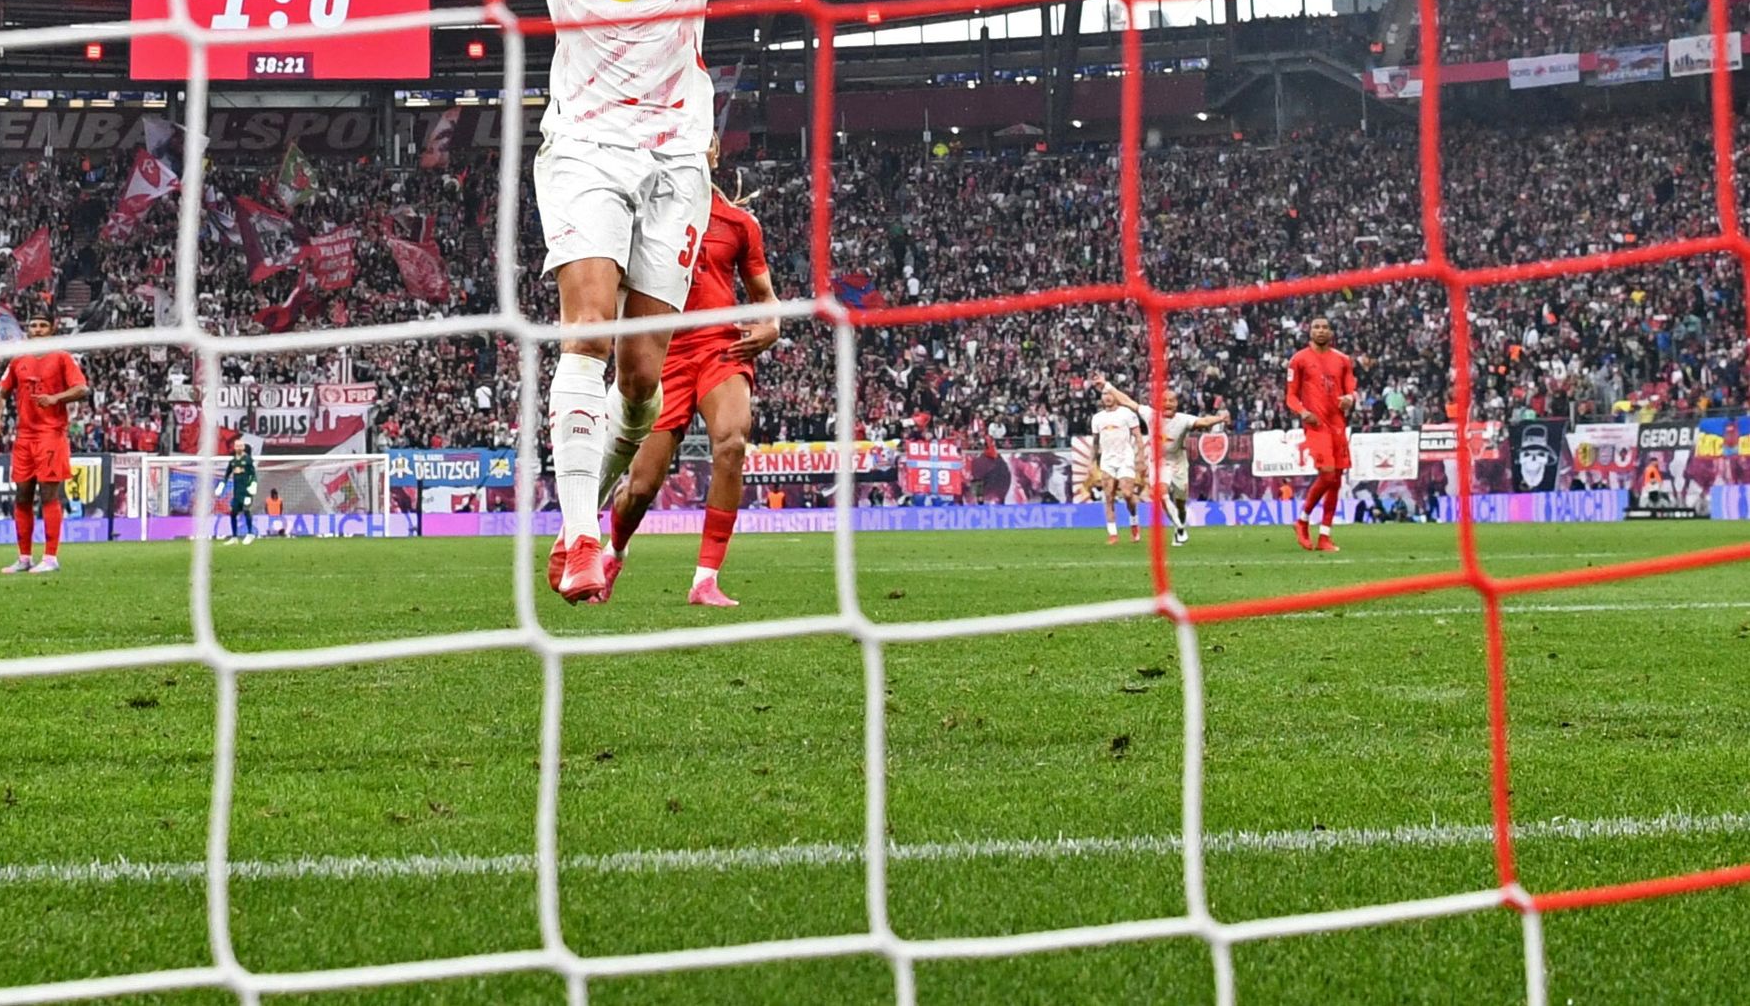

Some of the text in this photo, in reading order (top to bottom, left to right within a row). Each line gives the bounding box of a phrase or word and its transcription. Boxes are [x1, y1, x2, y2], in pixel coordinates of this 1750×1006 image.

[255, 57, 305, 74] 38:21
[280, 385, 314, 408] 147
[258, 414, 307, 435] BULLS
[572, 426, 592, 436] RBL
[46, 450, 55, 467] 7
[909, 442, 960, 457] BLOCK
[414, 461, 480, 480] DELITZSCH
[742, 450, 868, 473] BENNEWIZ
[745, 474, 811, 485] ULDENTAL
[265, 513, 387, 536] RAUCH
[861, 509, 906, 531] MIT
[918, 505, 1078, 530] FRUCHTSAFT
